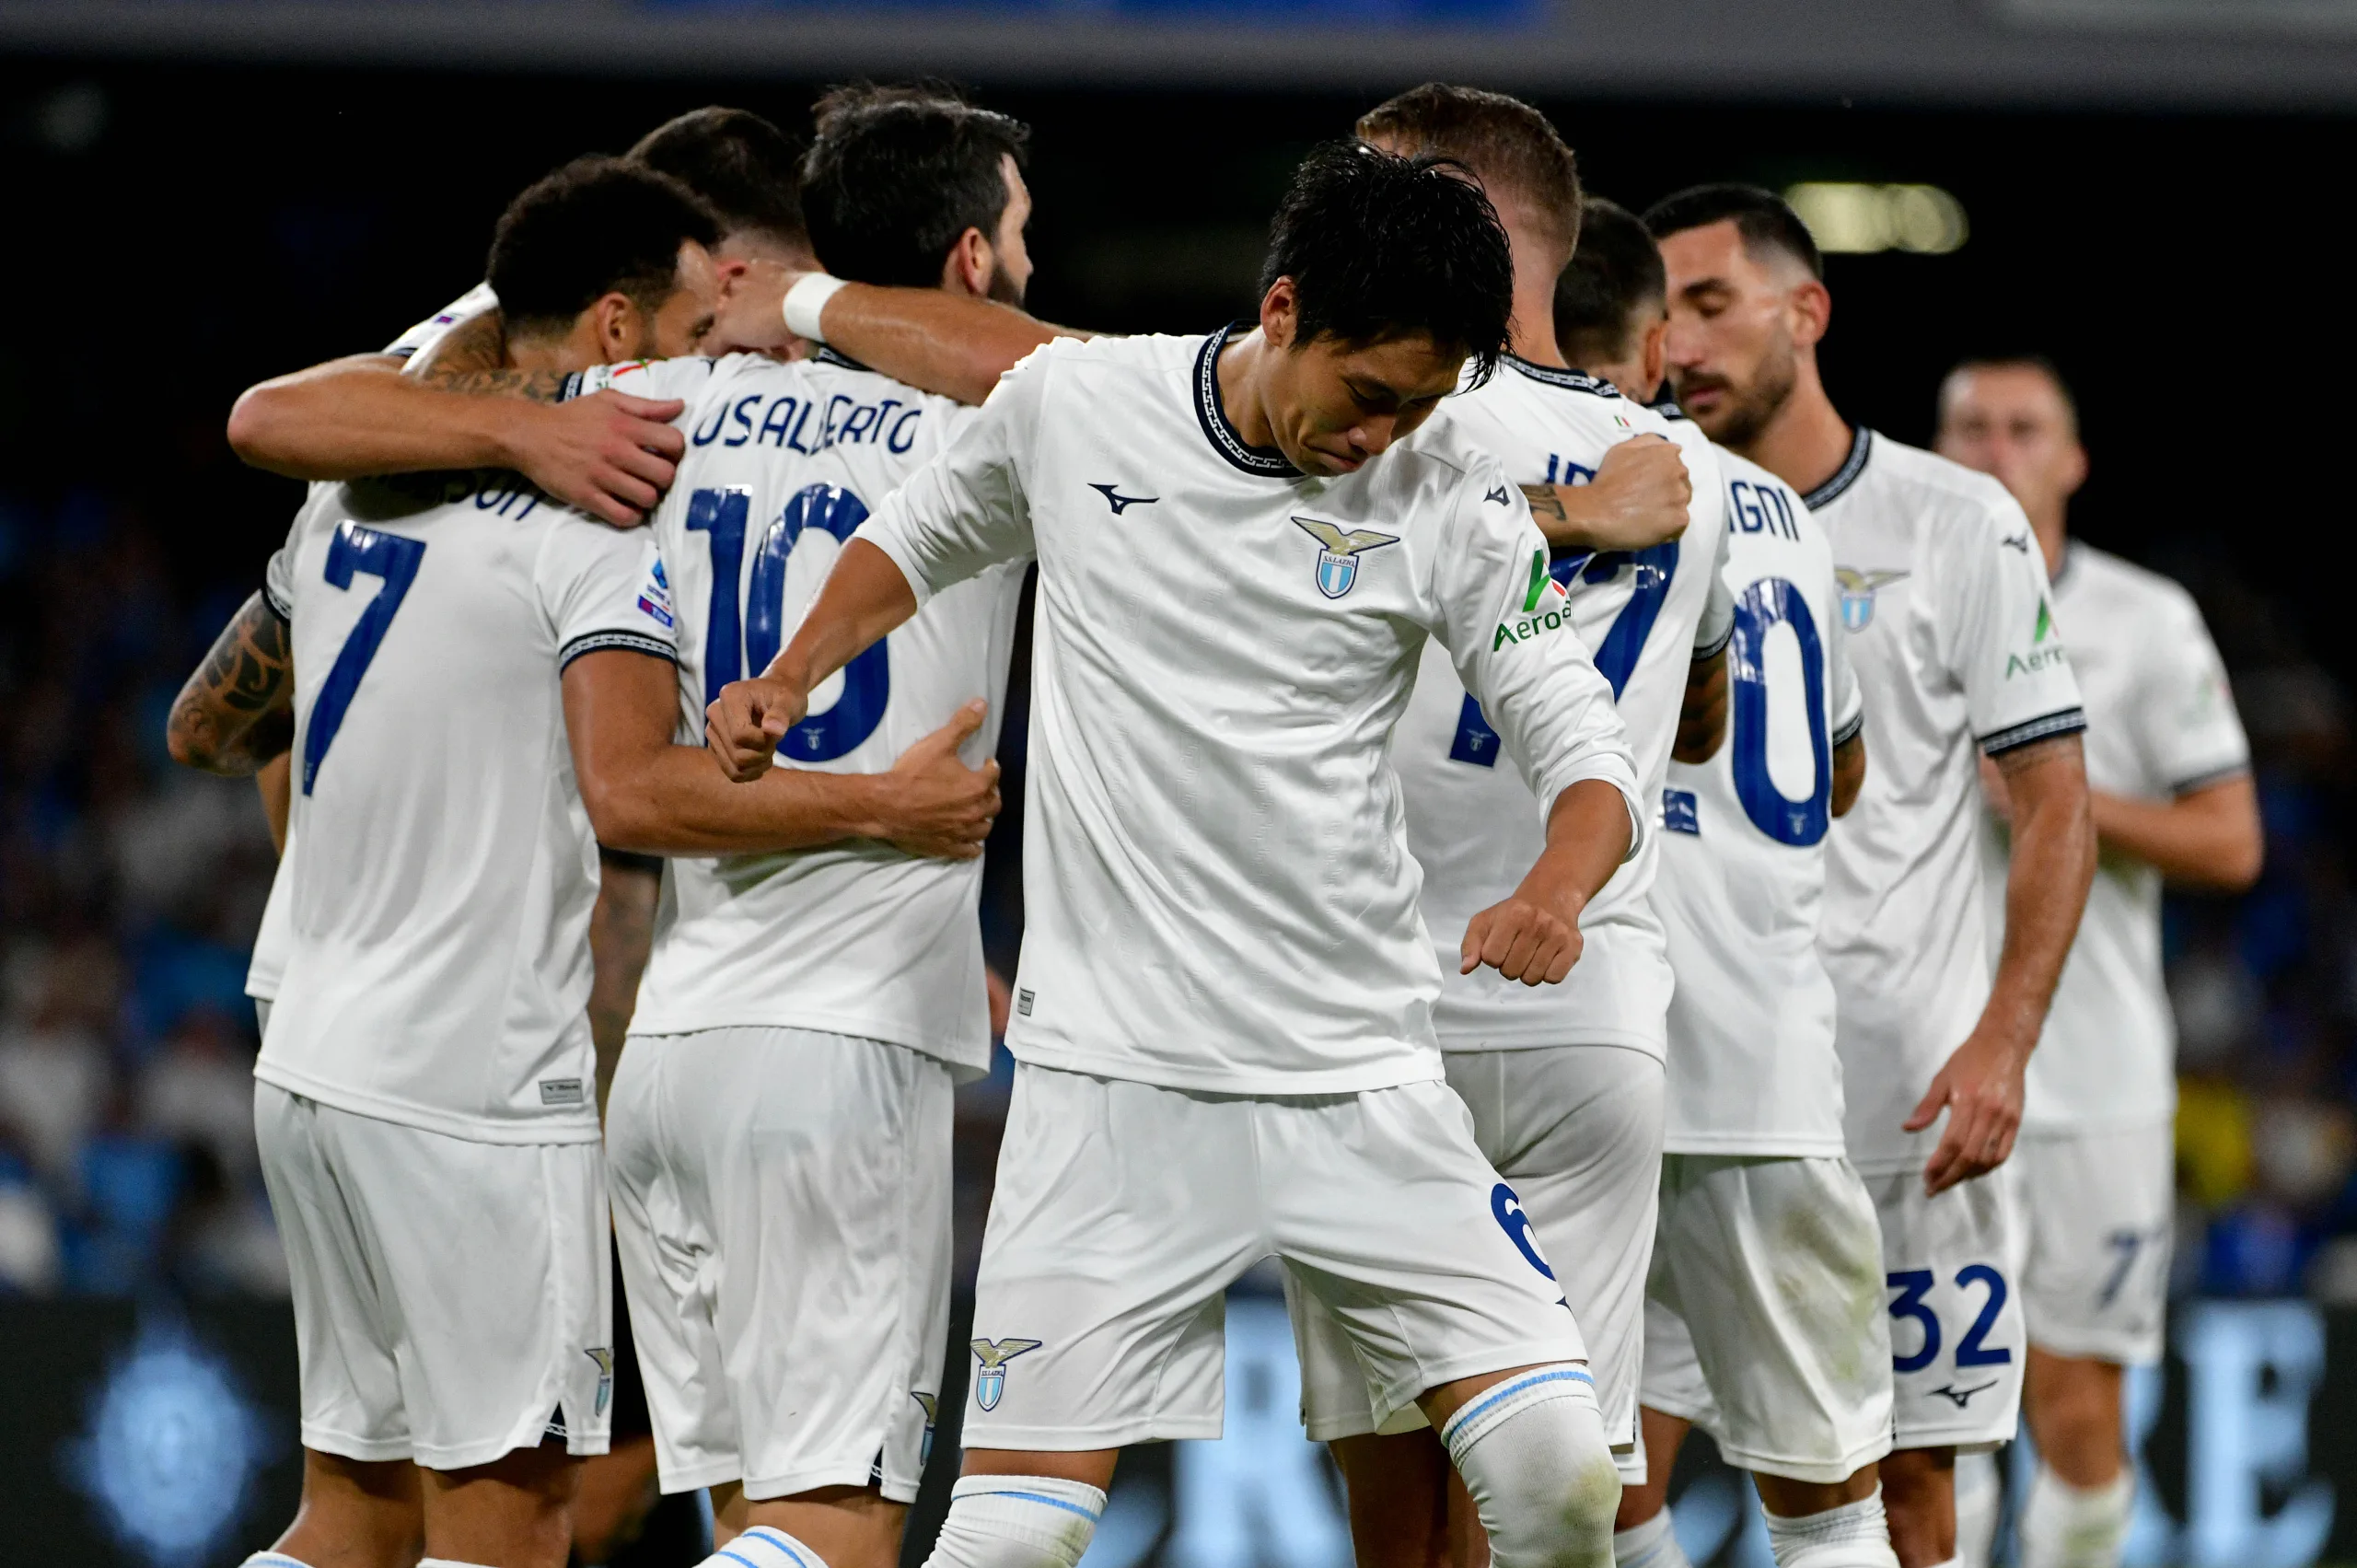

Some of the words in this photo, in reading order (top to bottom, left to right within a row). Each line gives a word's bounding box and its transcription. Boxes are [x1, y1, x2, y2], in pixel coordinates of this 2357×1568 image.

[1728, 480, 1800, 542] GNI
[302, 519, 427, 797] 7
[686, 482, 890, 762] 10
[1490, 1182, 1557, 1283] 6
[1887, 1264, 2012, 1374] 32
